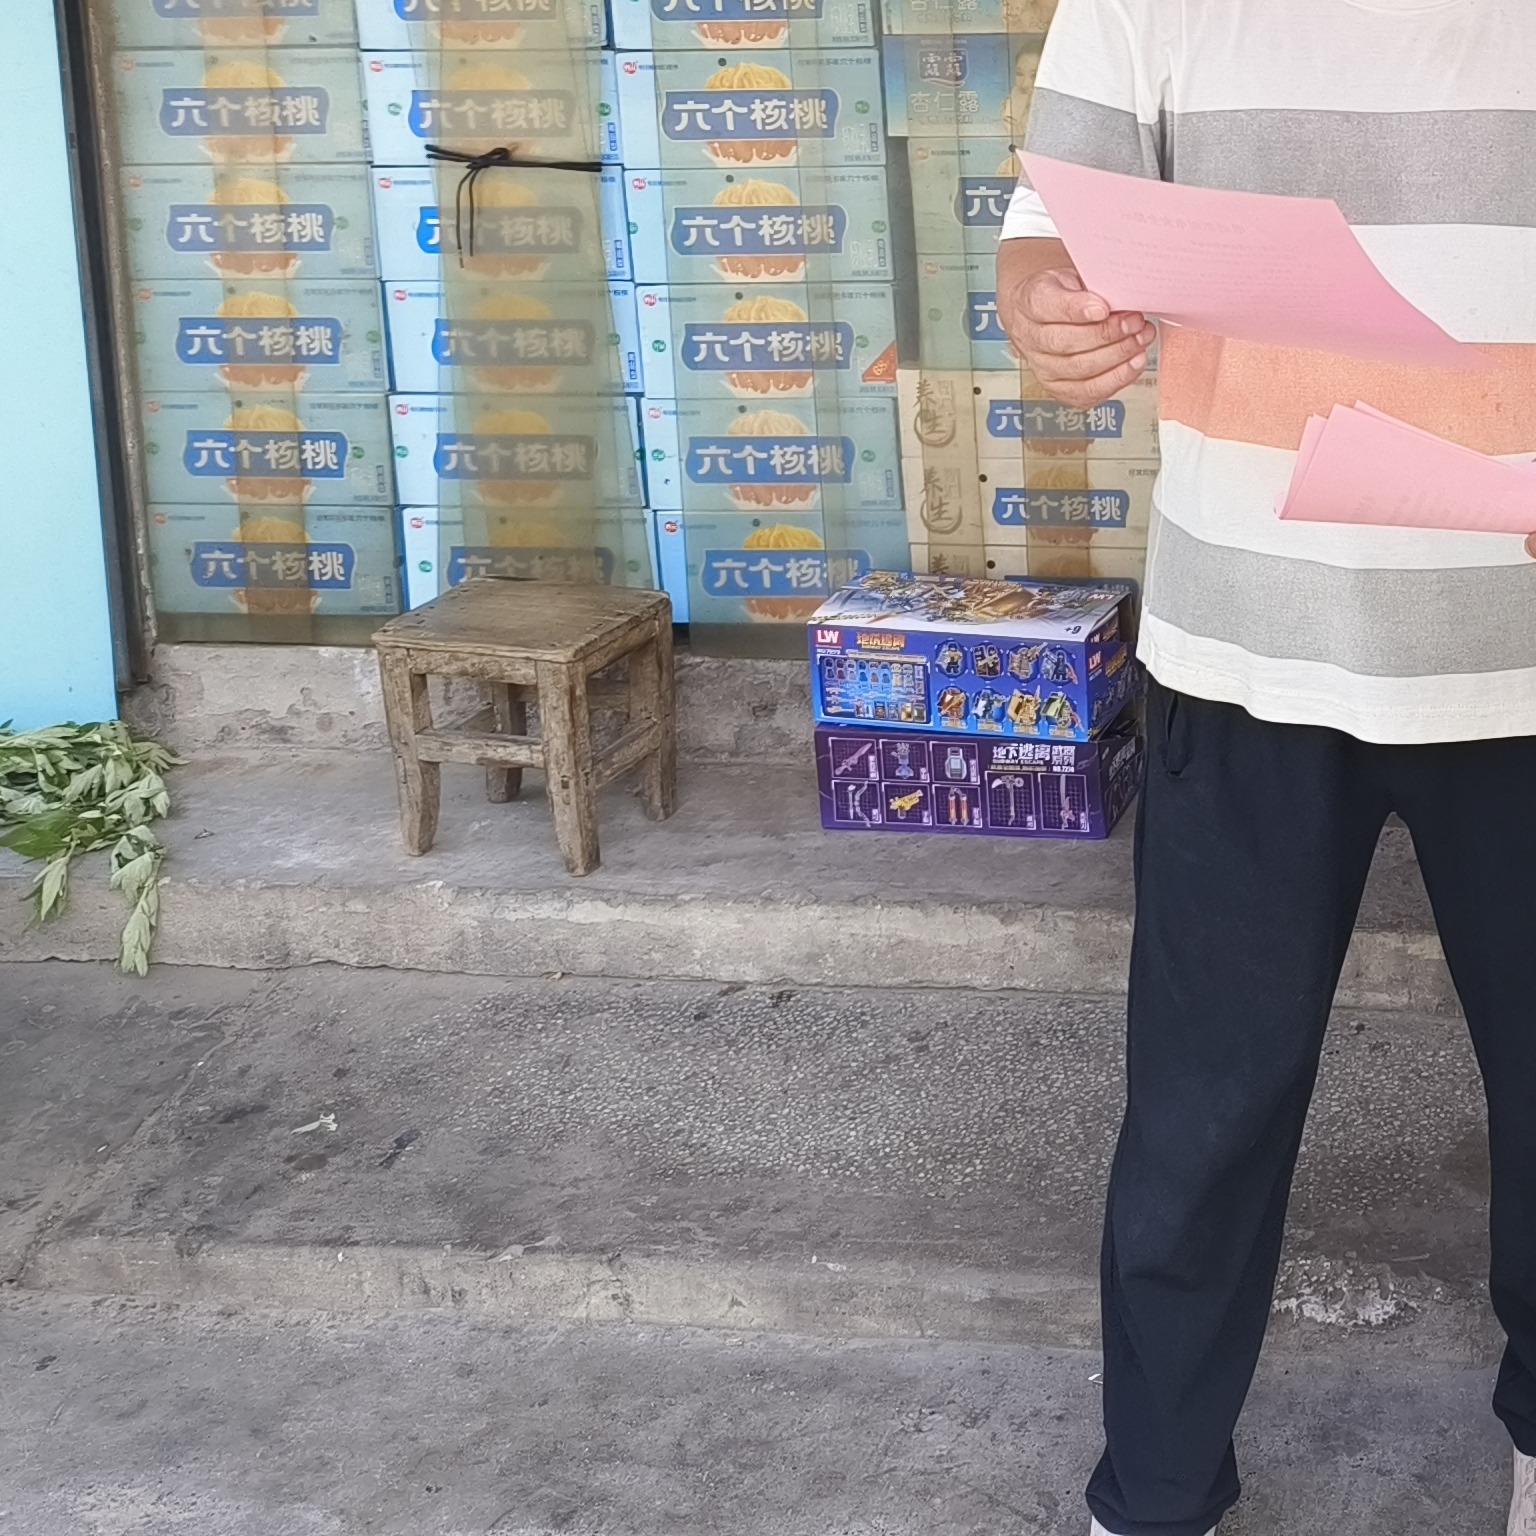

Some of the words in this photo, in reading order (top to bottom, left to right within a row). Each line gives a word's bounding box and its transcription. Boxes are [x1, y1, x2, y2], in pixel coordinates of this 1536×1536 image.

[170, 94, 322, 128] 六个核桃
[419, 98, 568, 131] 六个核桃
[672, 98, 829, 131] 六个核桃
[911, 90, 979, 113] 杏仁露
[176, 212, 325, 246] 六个核桃
[426, 215, 575, 248] 六个核桃
[681, 213, 836, 247] 六个核桃
[185, 325, 336, 358] 六个核桃
[440, 327, 588, 359] 六个核桃
[691, 330, 844, 363] 六个核桃
[996, 406, 1117, 432] 六个核桃
[192, 437, 339, 470] 六个核桃
[443, 441, 589, 473] 六个核桃
[695, 443, 845, 476] 六个核桃
[1001, 494, 1122, 521] 六个核桃
[200, 548, 346, 582] 六个核桃
[711, 557, 859, 589] 六个核桃
[817, 629, 839, 644] LW
[993, 743, 1051, 762] 地下逃离
